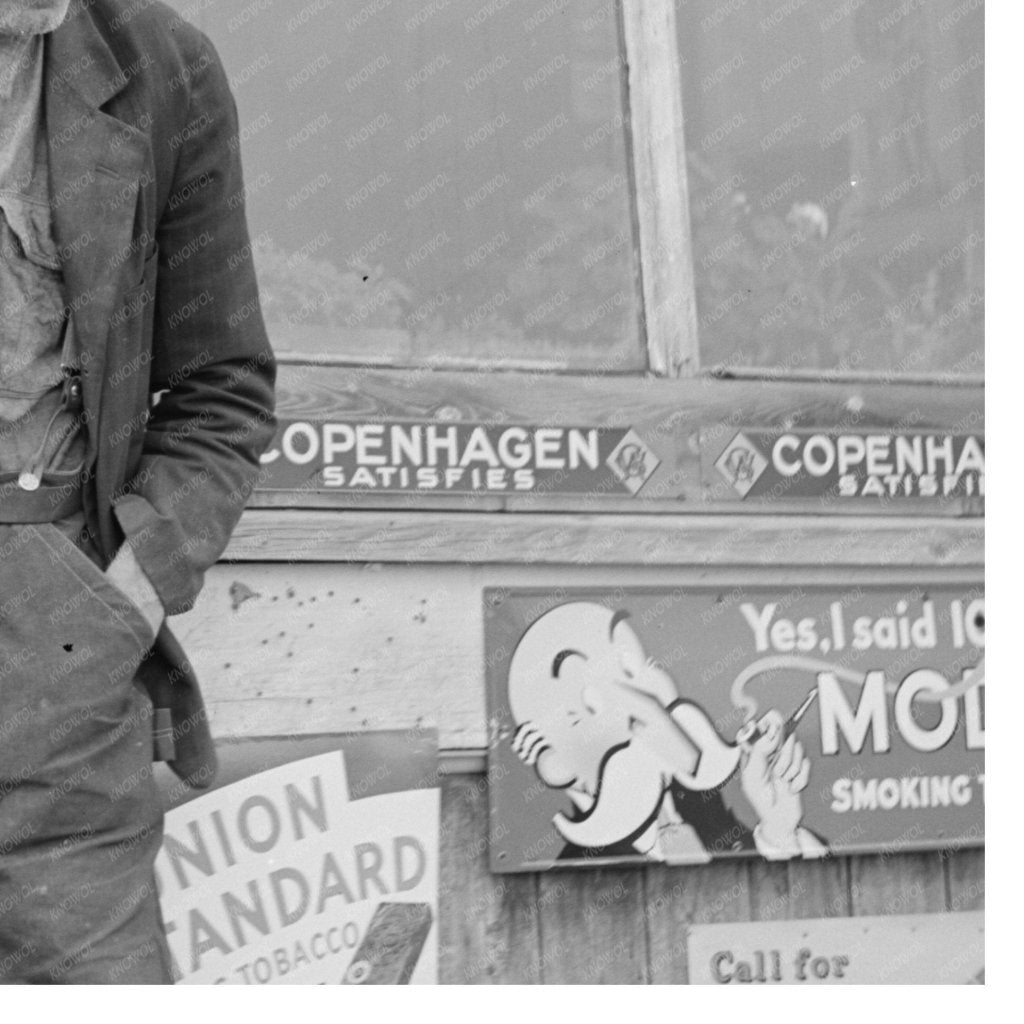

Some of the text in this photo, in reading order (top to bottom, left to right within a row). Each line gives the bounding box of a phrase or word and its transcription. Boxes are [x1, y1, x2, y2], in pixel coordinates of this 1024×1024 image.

[259, 422, 600, 470] OPENHAGEN
[322, 465, 536, 491] SATISFIES
[852, 600, 937, 650] said
[831, 775, 972, 813] SMOKING
[165, 836, 427, 974] ANDARD
[709, 946, 851, 984] Call for
